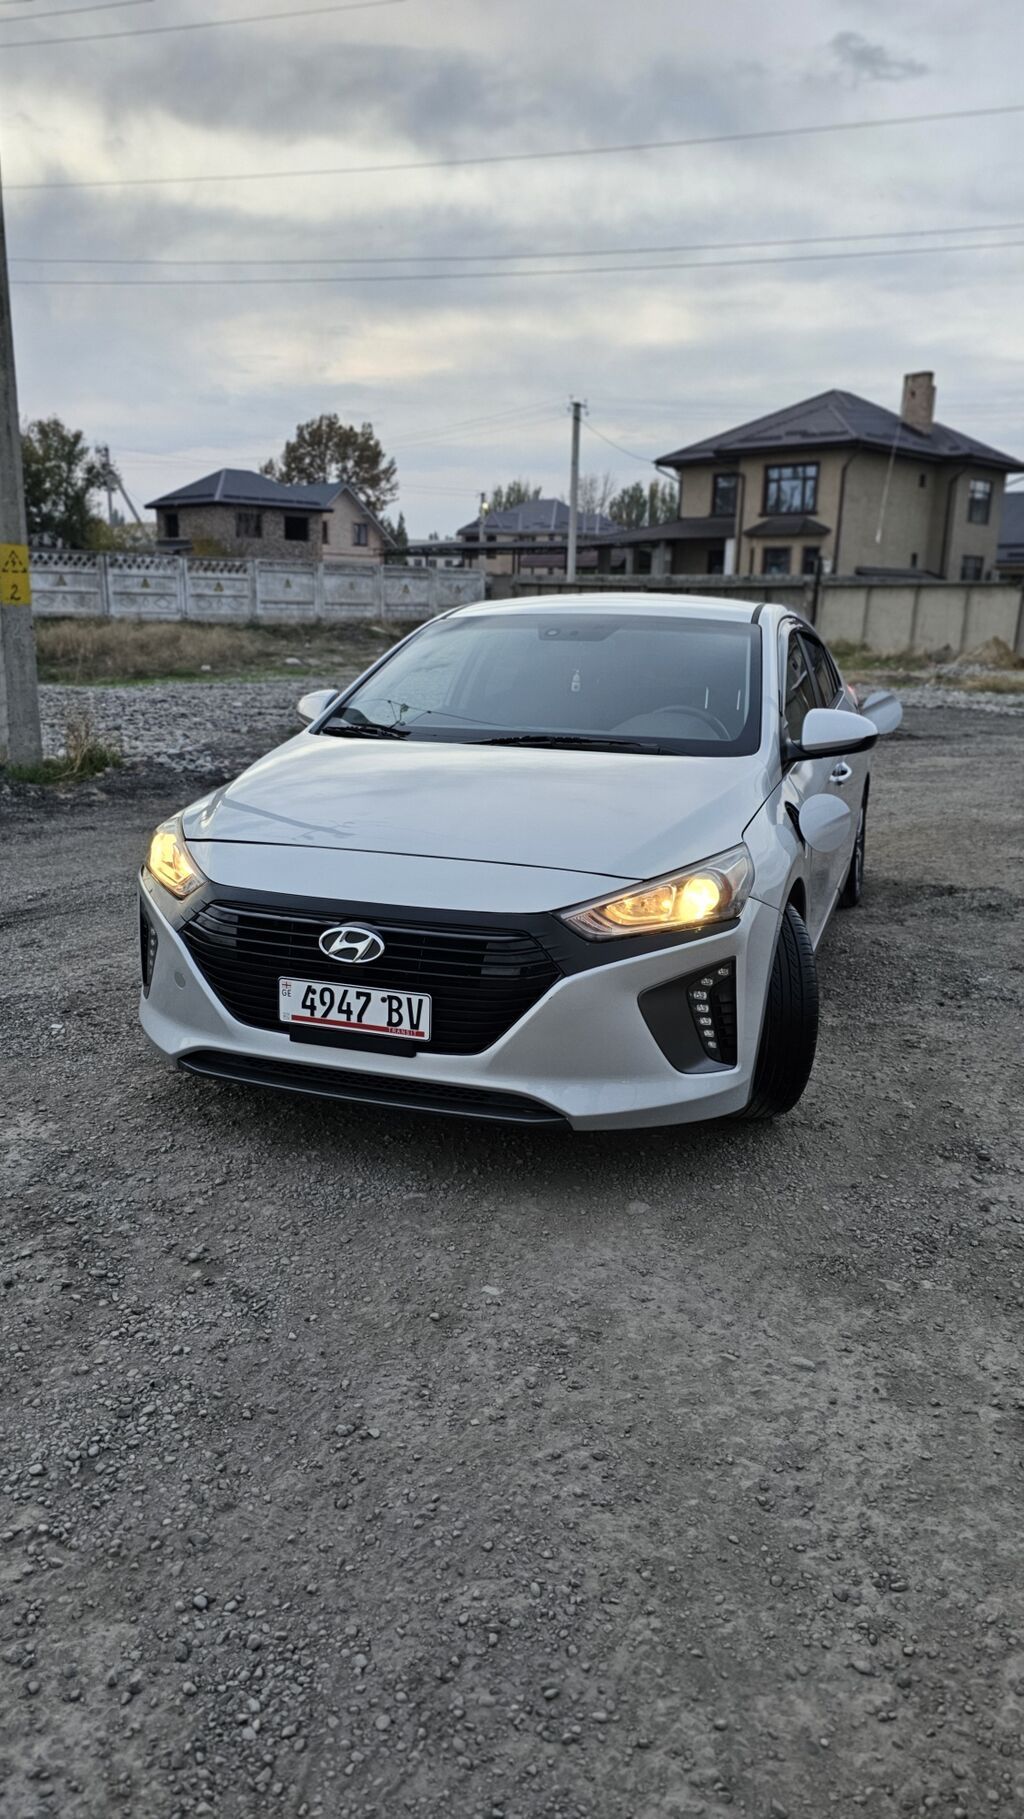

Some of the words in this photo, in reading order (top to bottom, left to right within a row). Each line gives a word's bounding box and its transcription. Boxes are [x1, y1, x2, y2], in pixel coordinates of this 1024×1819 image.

[10, 584, 21, 601] 2
[281, 988, 292, 997] GE
[301, 985, 372, 1023] 4947
[387, 995, 424, 1030] BV
[388, 1027, 417, 1036] TRANSIT
